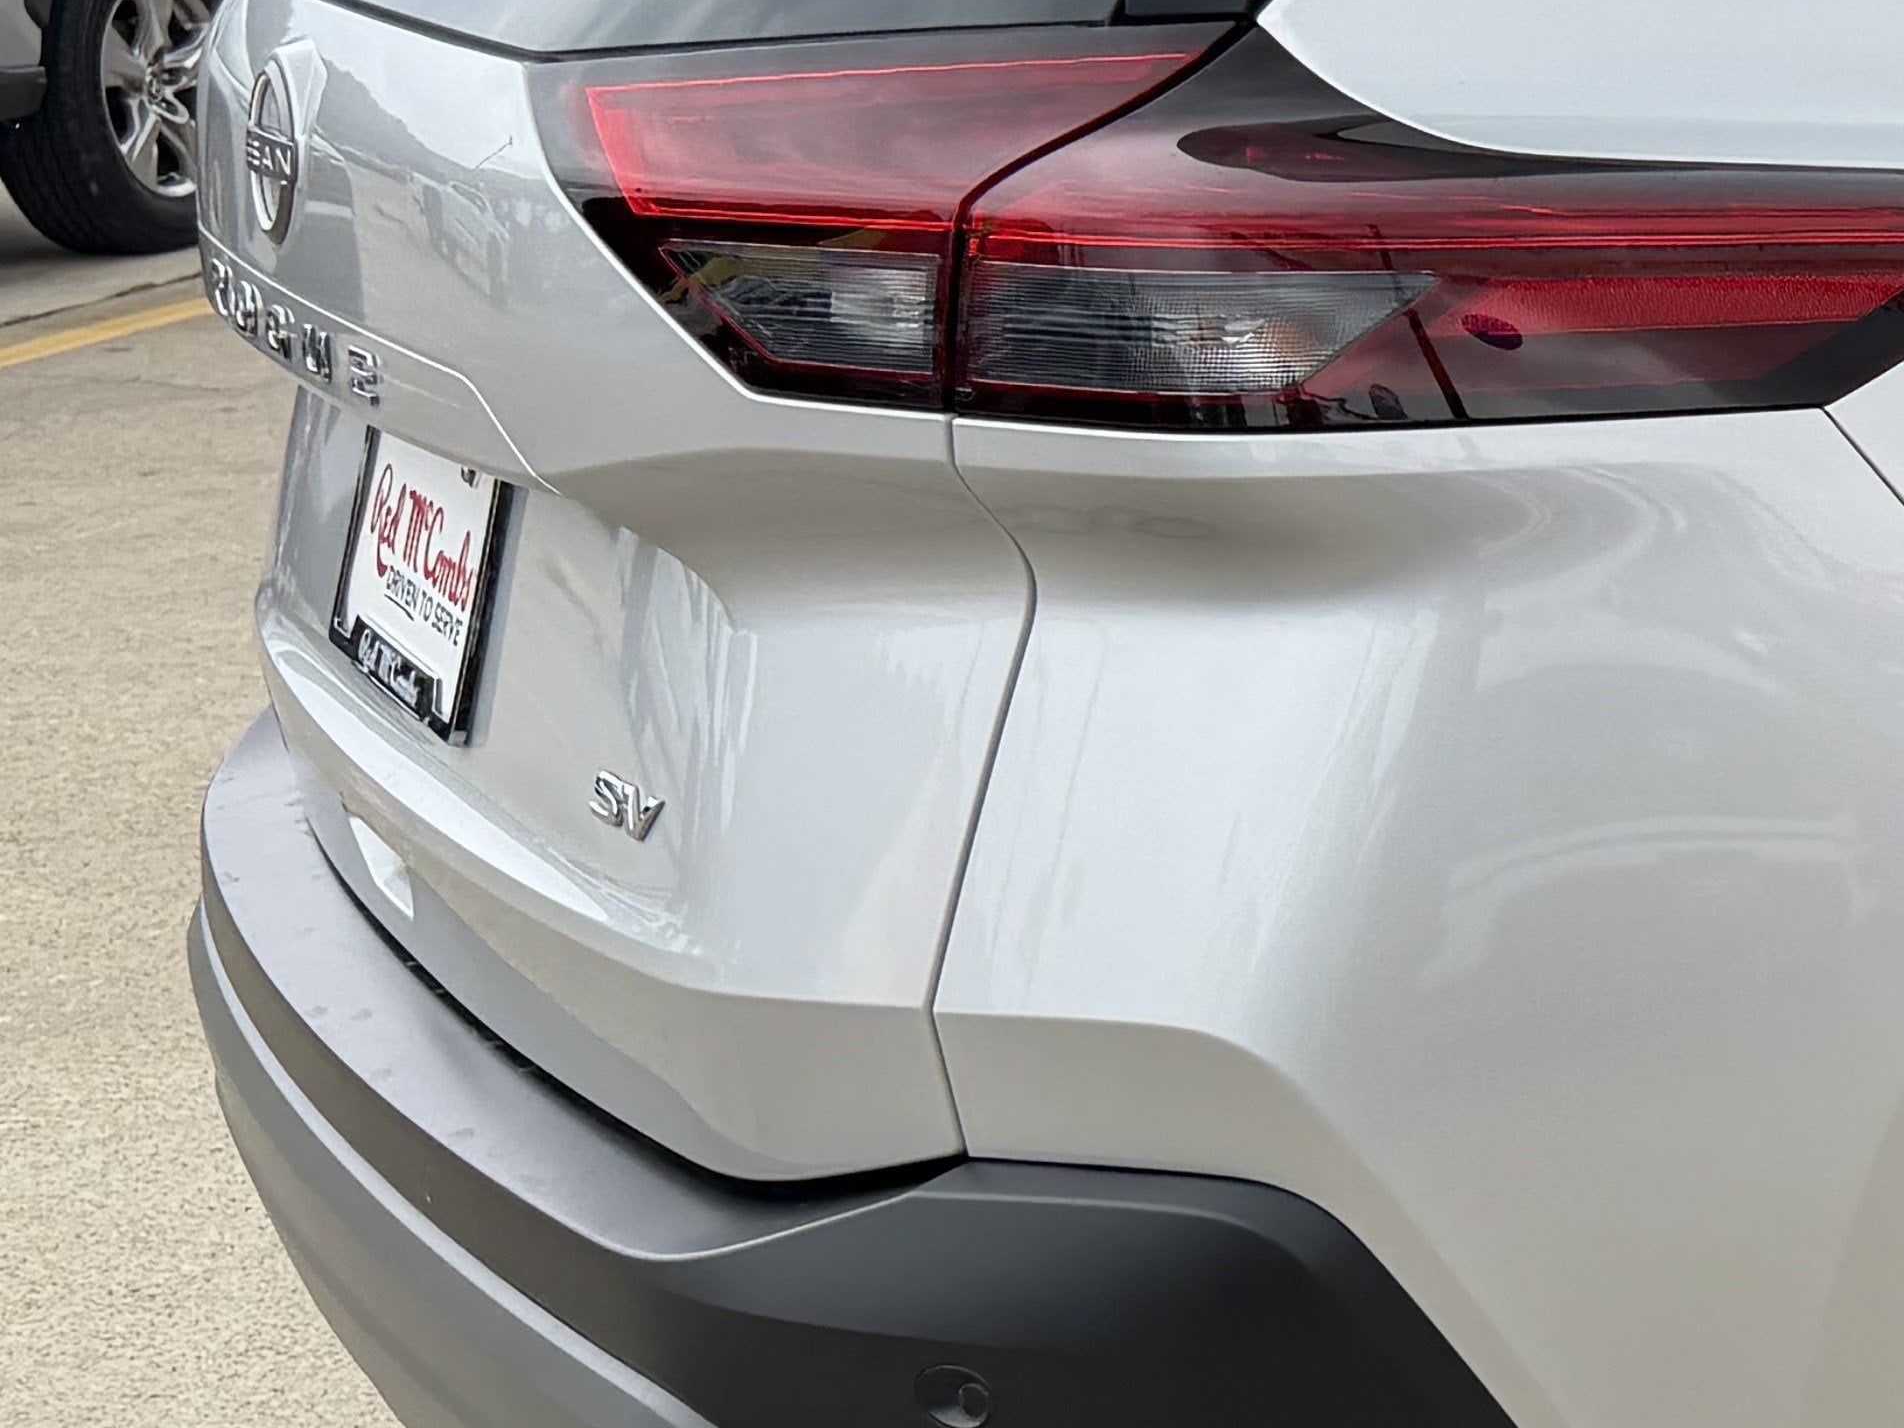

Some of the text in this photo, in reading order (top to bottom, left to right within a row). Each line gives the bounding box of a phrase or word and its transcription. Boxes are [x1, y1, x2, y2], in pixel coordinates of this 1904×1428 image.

[371, 463, 407, 578] Red
[386, 565, 463, 646] DRIVEN TO SERVE
[588, 769, 666, 842] SV
